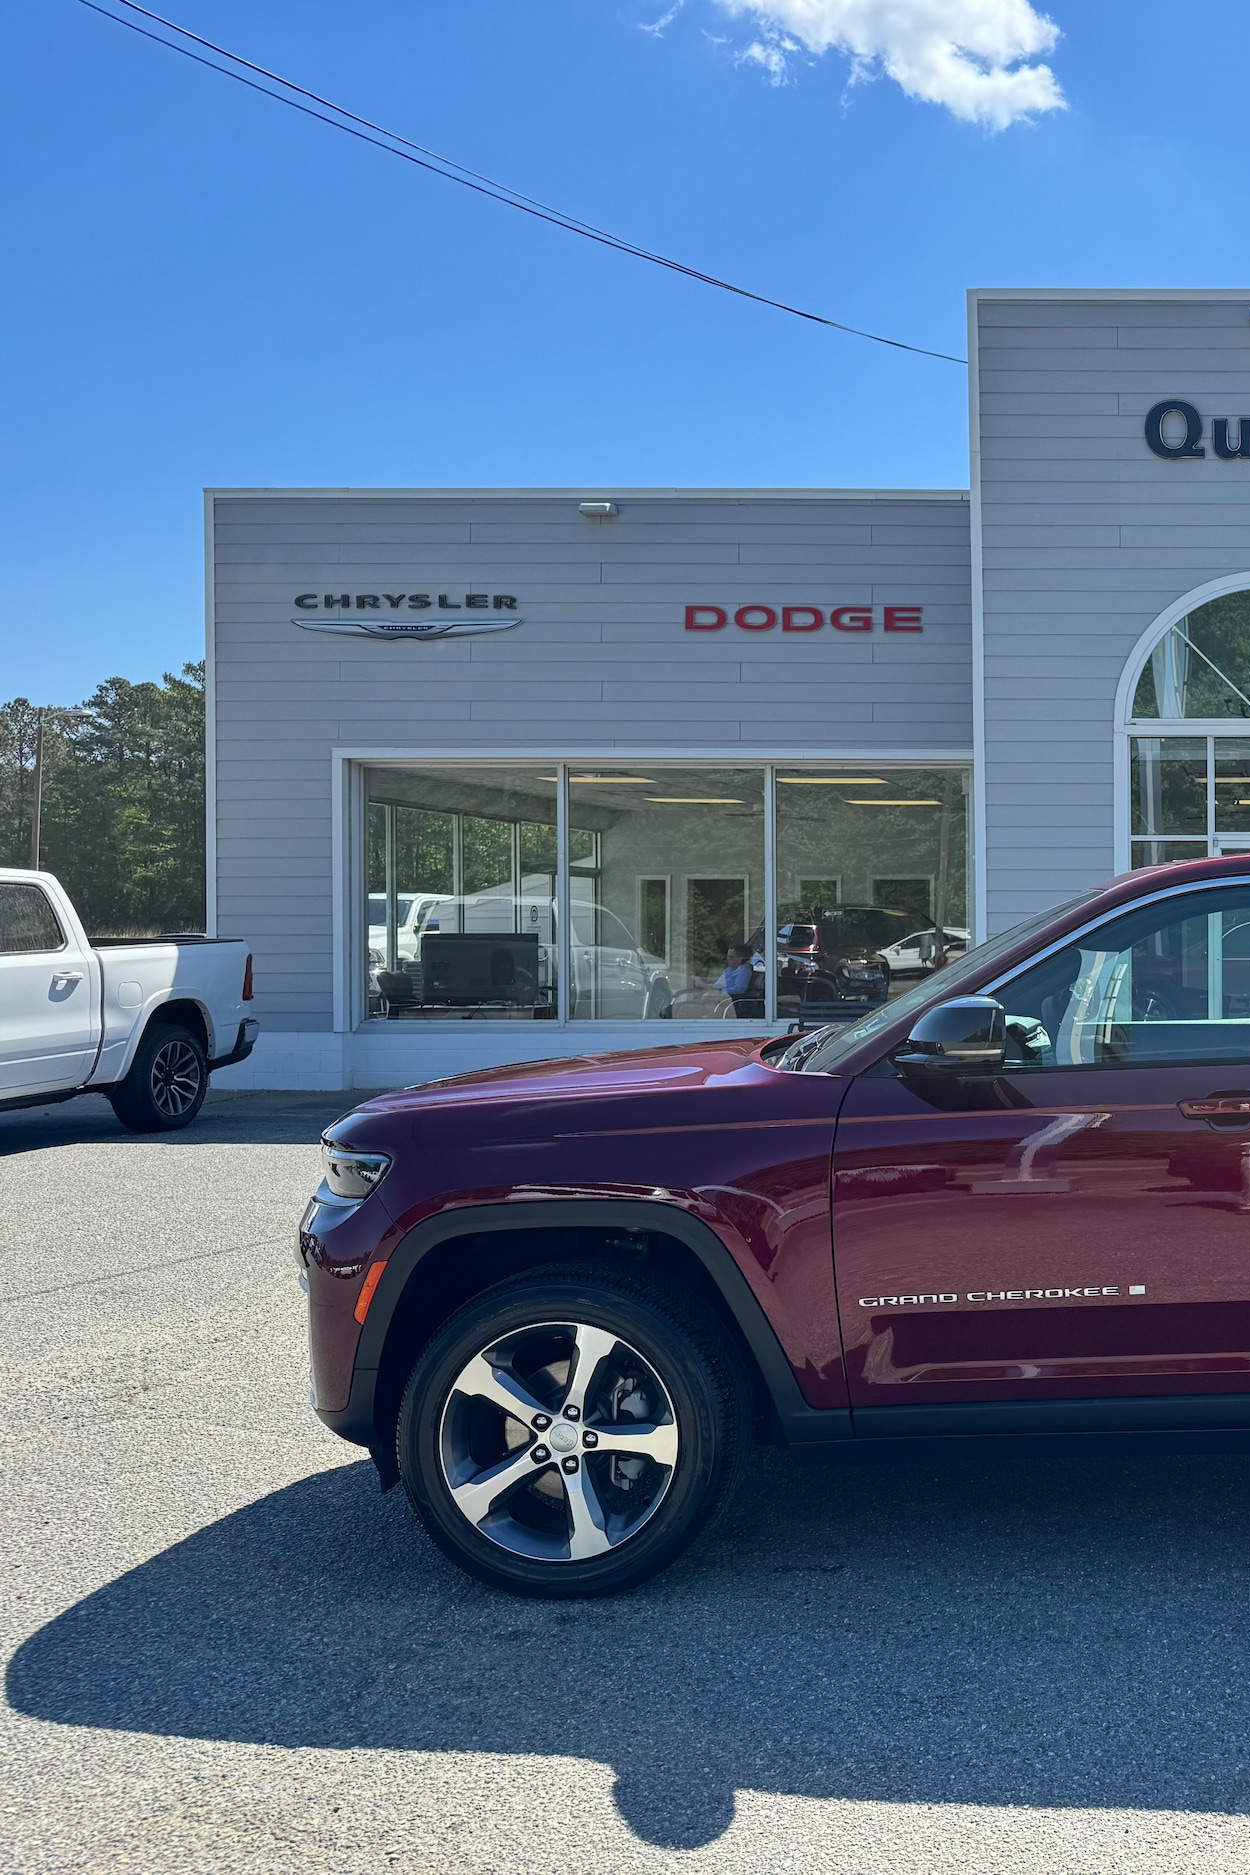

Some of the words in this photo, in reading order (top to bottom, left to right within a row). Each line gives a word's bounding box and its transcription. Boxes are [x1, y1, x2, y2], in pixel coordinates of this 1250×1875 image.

[294, 593, 518, 610] CHRYSLER
[685, 606, 923, 633] DODGE
[858, 1292, 958, 1307] GRAND
[966, 1286, 1120, 1302] CHEROKEE
